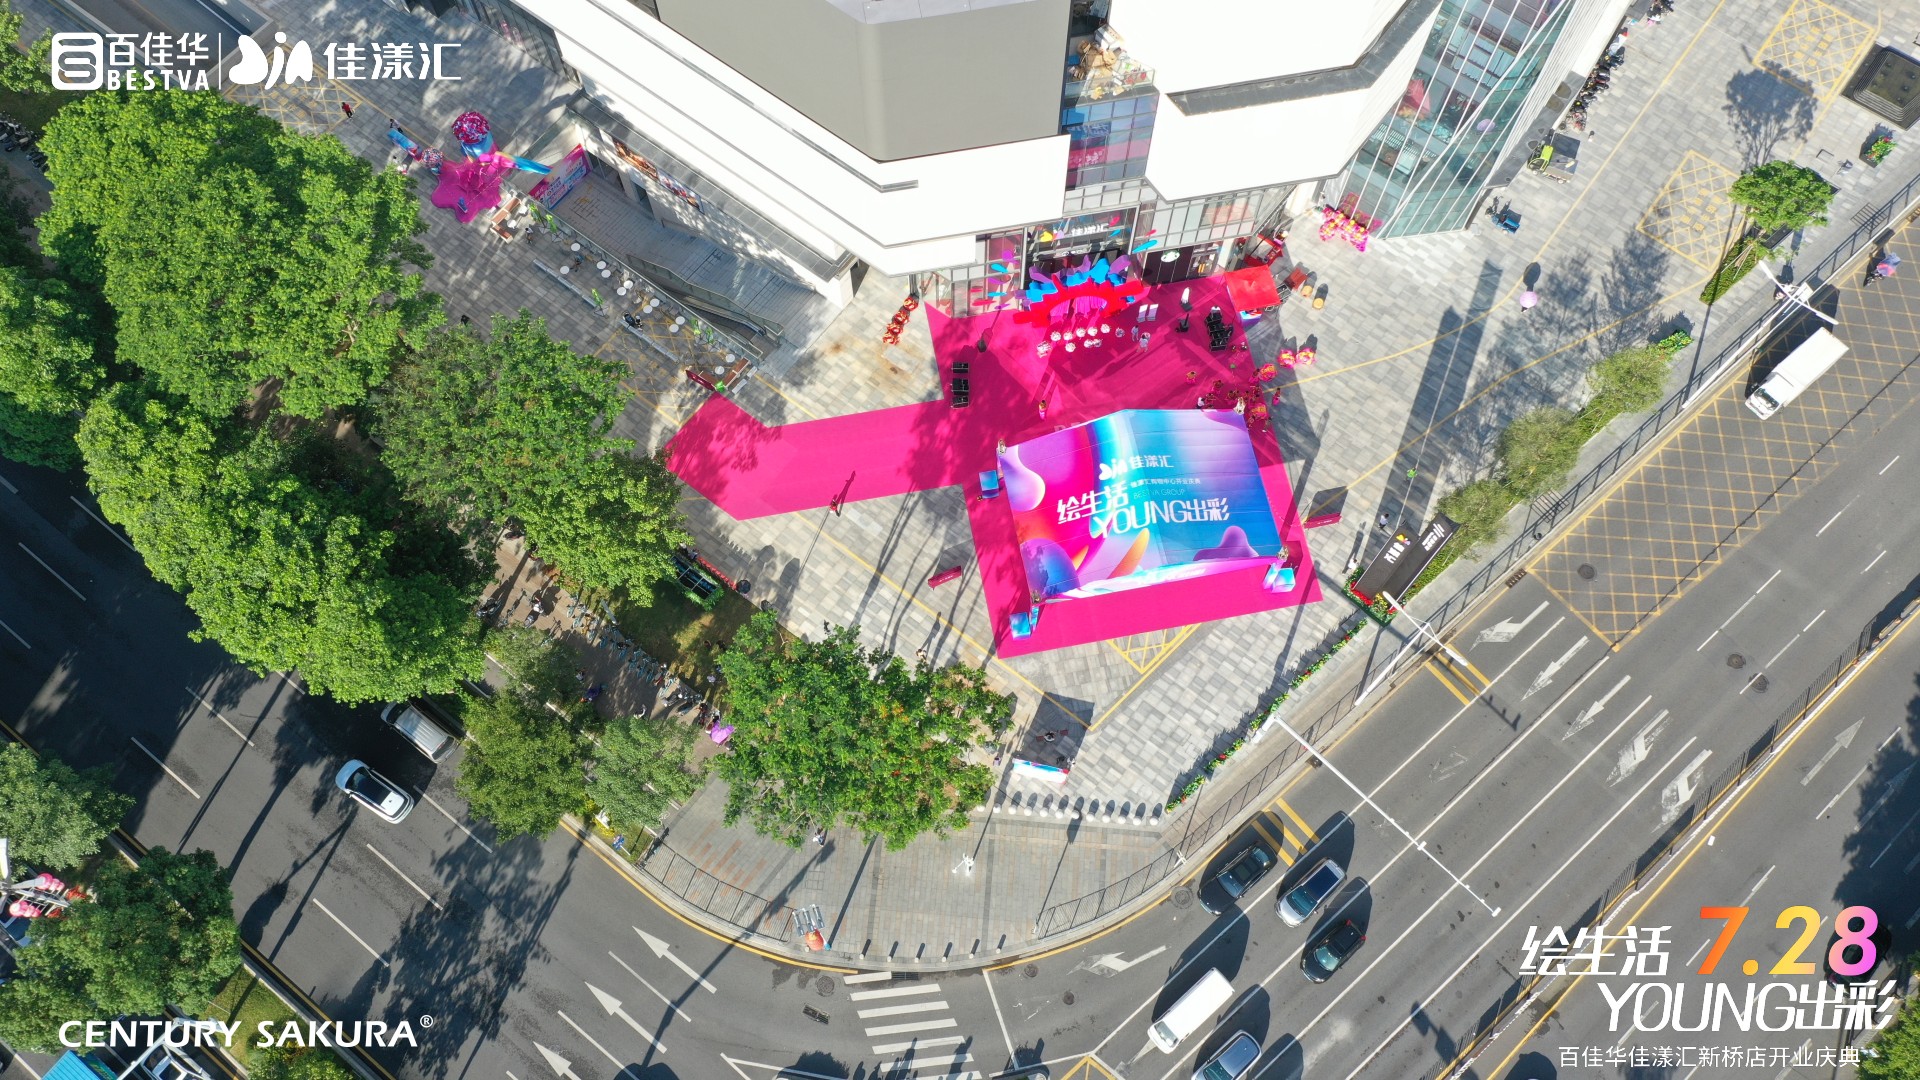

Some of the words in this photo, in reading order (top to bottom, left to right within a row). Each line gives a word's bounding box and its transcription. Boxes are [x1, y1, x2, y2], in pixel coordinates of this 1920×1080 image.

[1129, 455, 1174, 470] 佳漾汇
[1056, 480, 1129, 525] 绘生活
[1161, 488, 1185, 496] GROUP
[1092, 497, 1230, 539] YOUNG出彩
